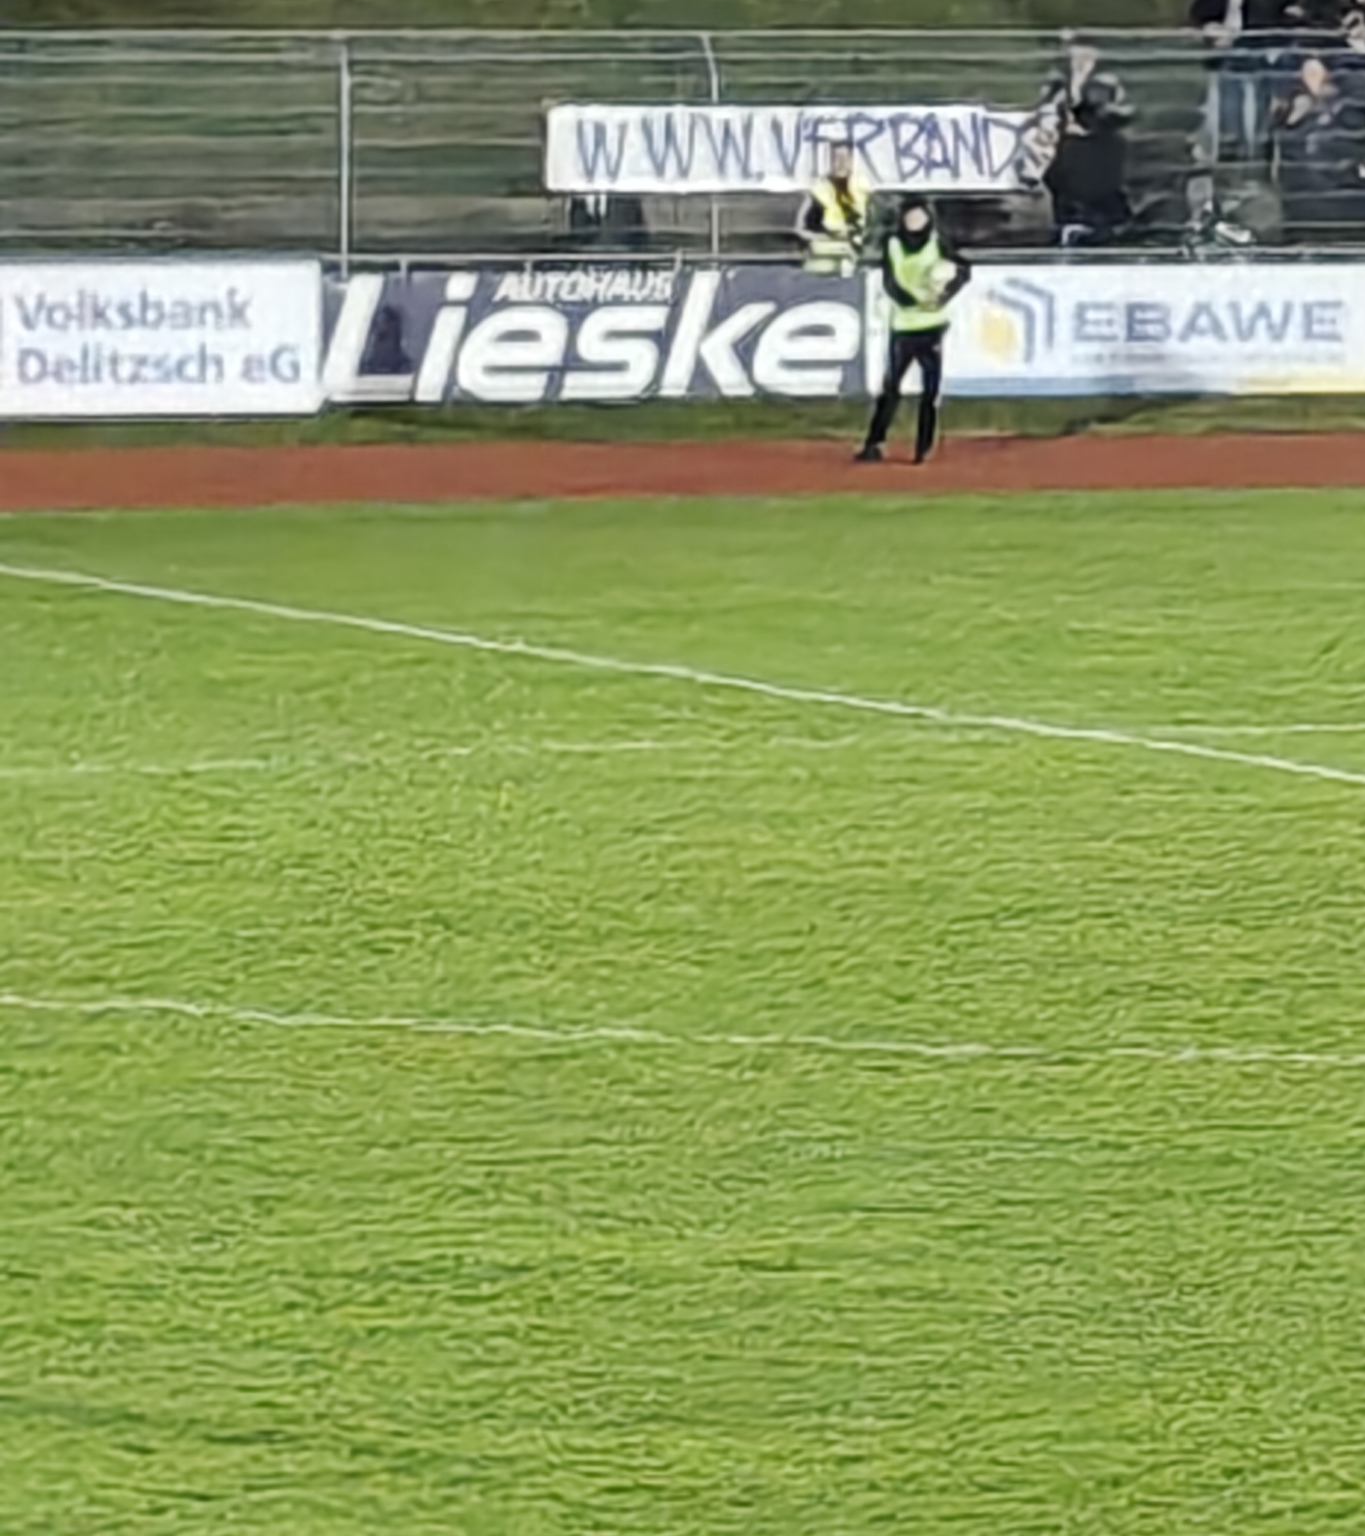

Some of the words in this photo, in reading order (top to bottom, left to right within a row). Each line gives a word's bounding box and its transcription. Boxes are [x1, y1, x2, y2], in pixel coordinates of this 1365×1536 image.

[493, 266, 676, 302] AUTOHAUS
[14, 287, 253, 332] Volksbank
[1072, 300, 1346, 344] EBAWE
[321, 263, 861, 402] Lieske
[17, 342, 224, 385] Delitzsch
[240, 344, 302, 385] eG
